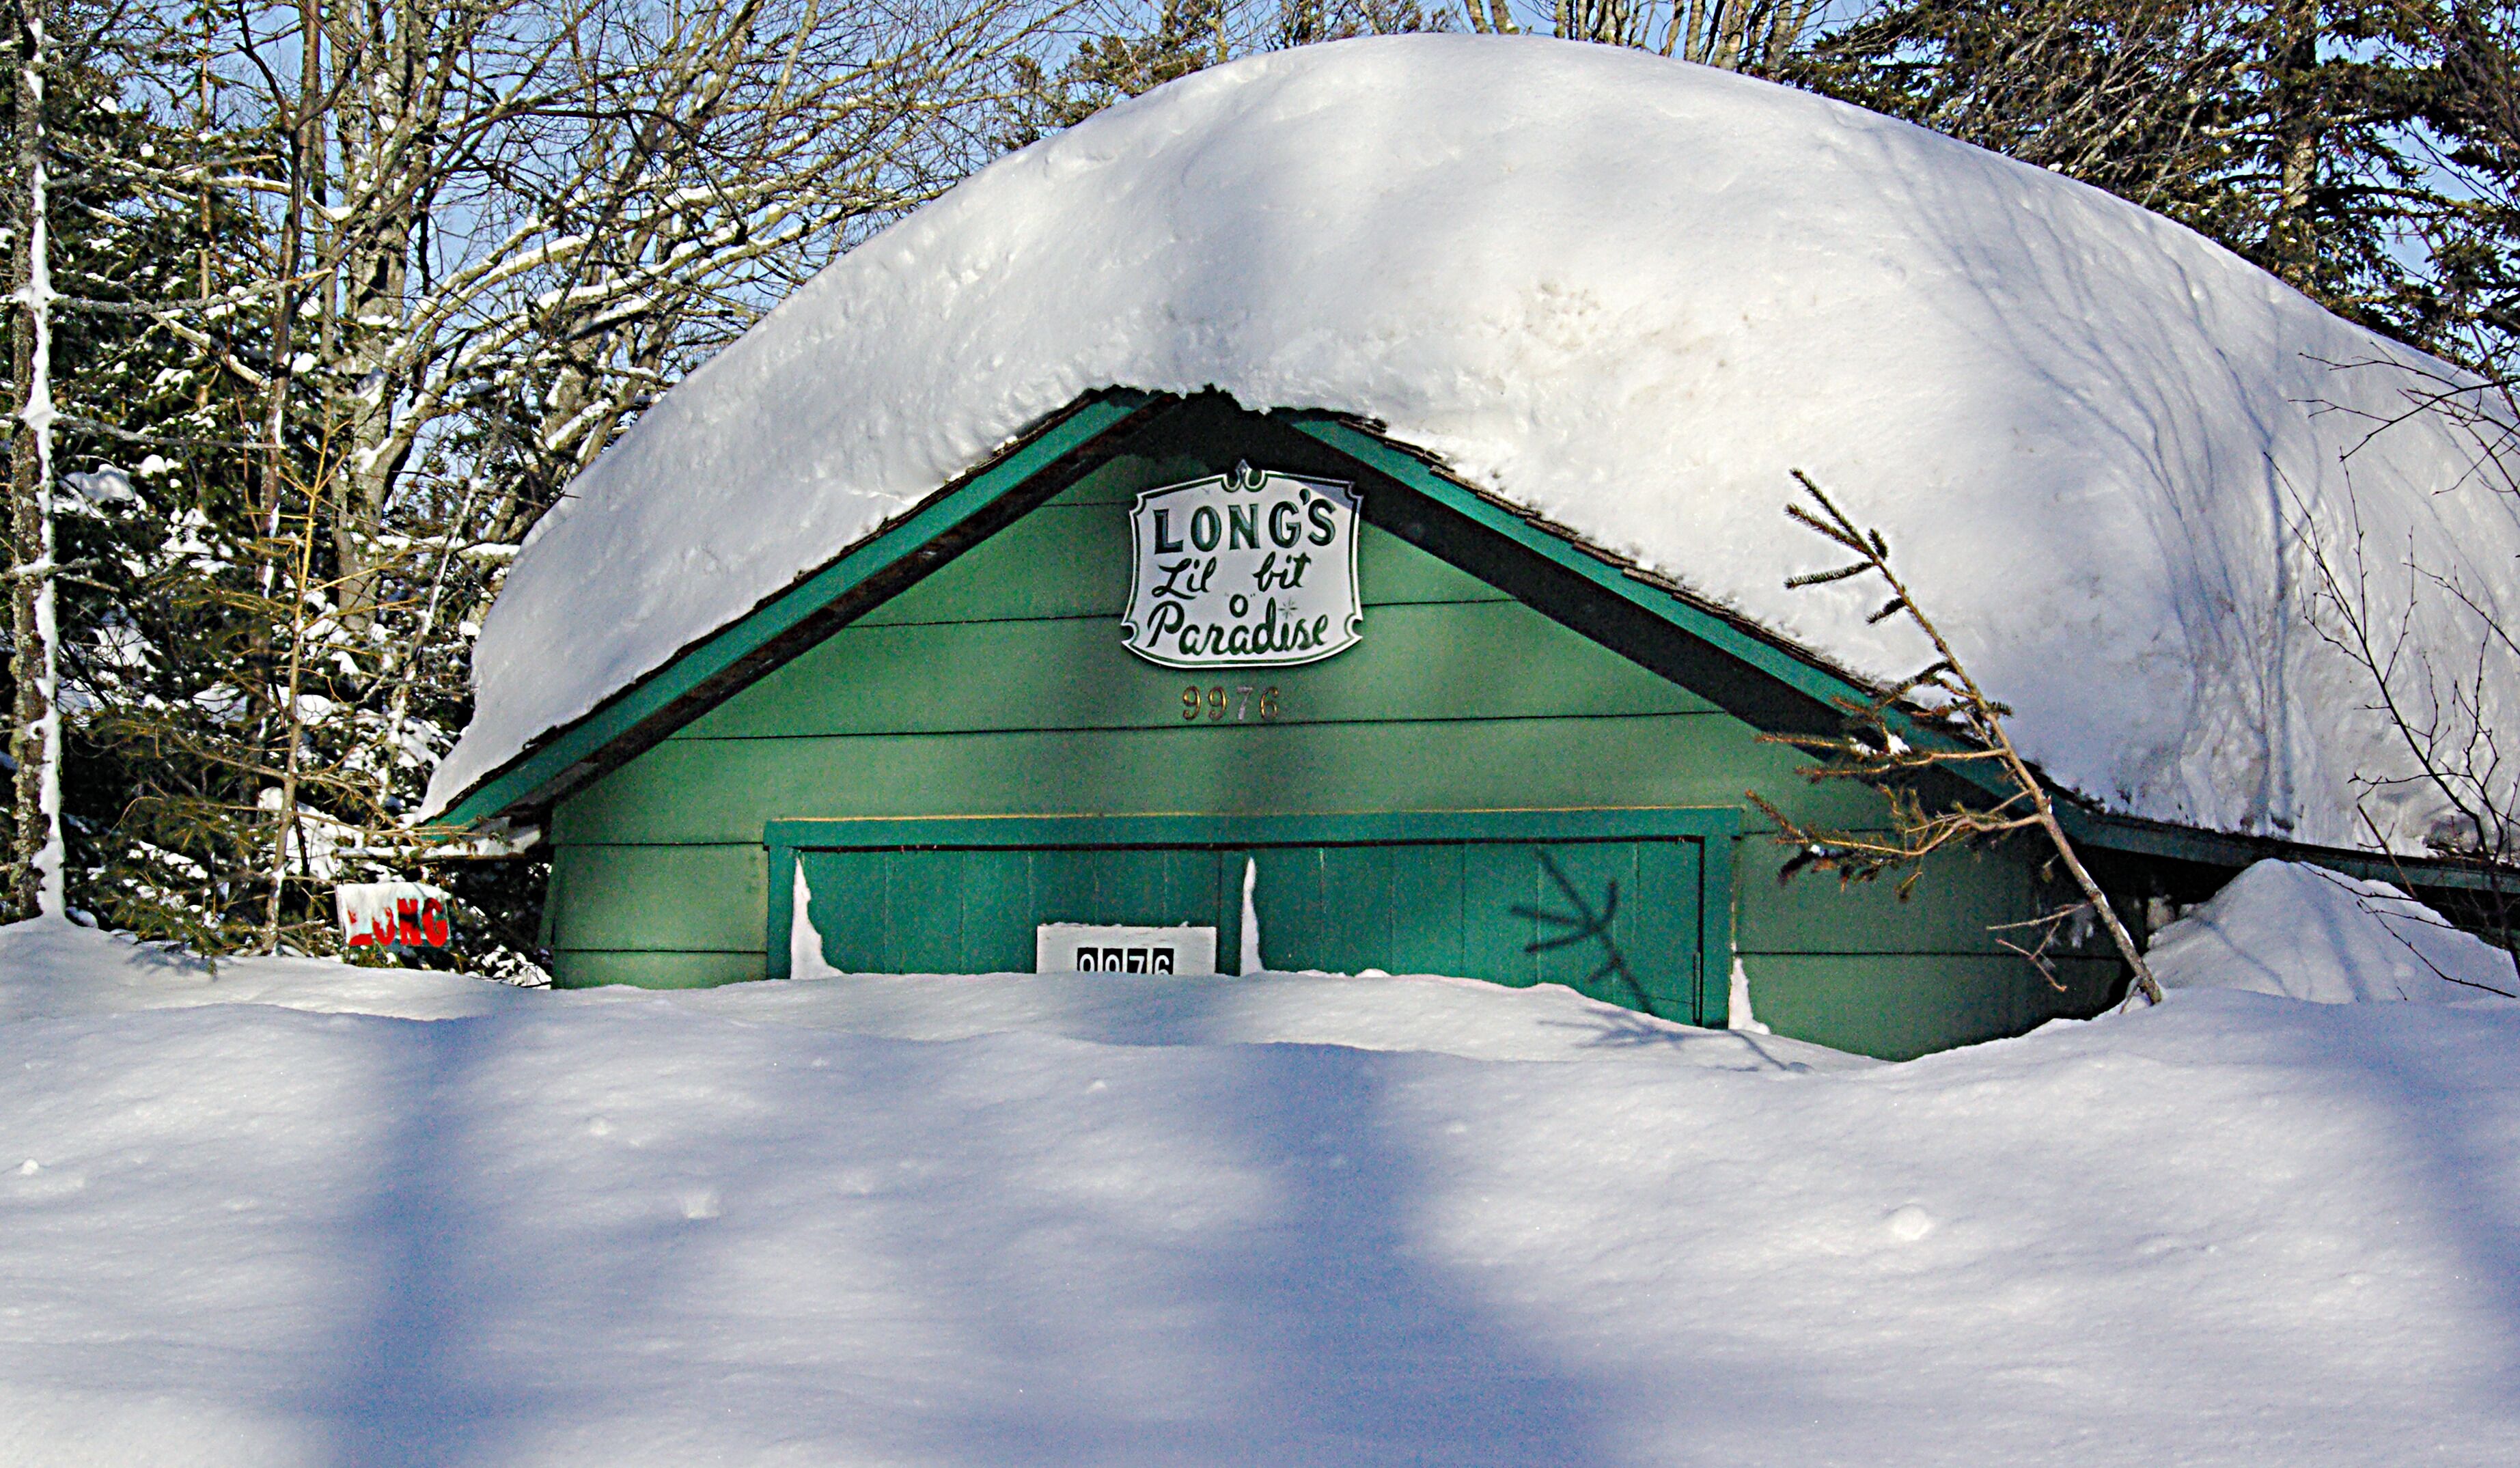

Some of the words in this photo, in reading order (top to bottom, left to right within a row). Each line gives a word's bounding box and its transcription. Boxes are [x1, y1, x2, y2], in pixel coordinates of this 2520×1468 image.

[1154, 488, 1336, 555] LONG'S
[1252, 551, 1312, 592] bit
[1146, 596, 1329, 656] Paradise
[1182, 686, 1279, 721] 9976
